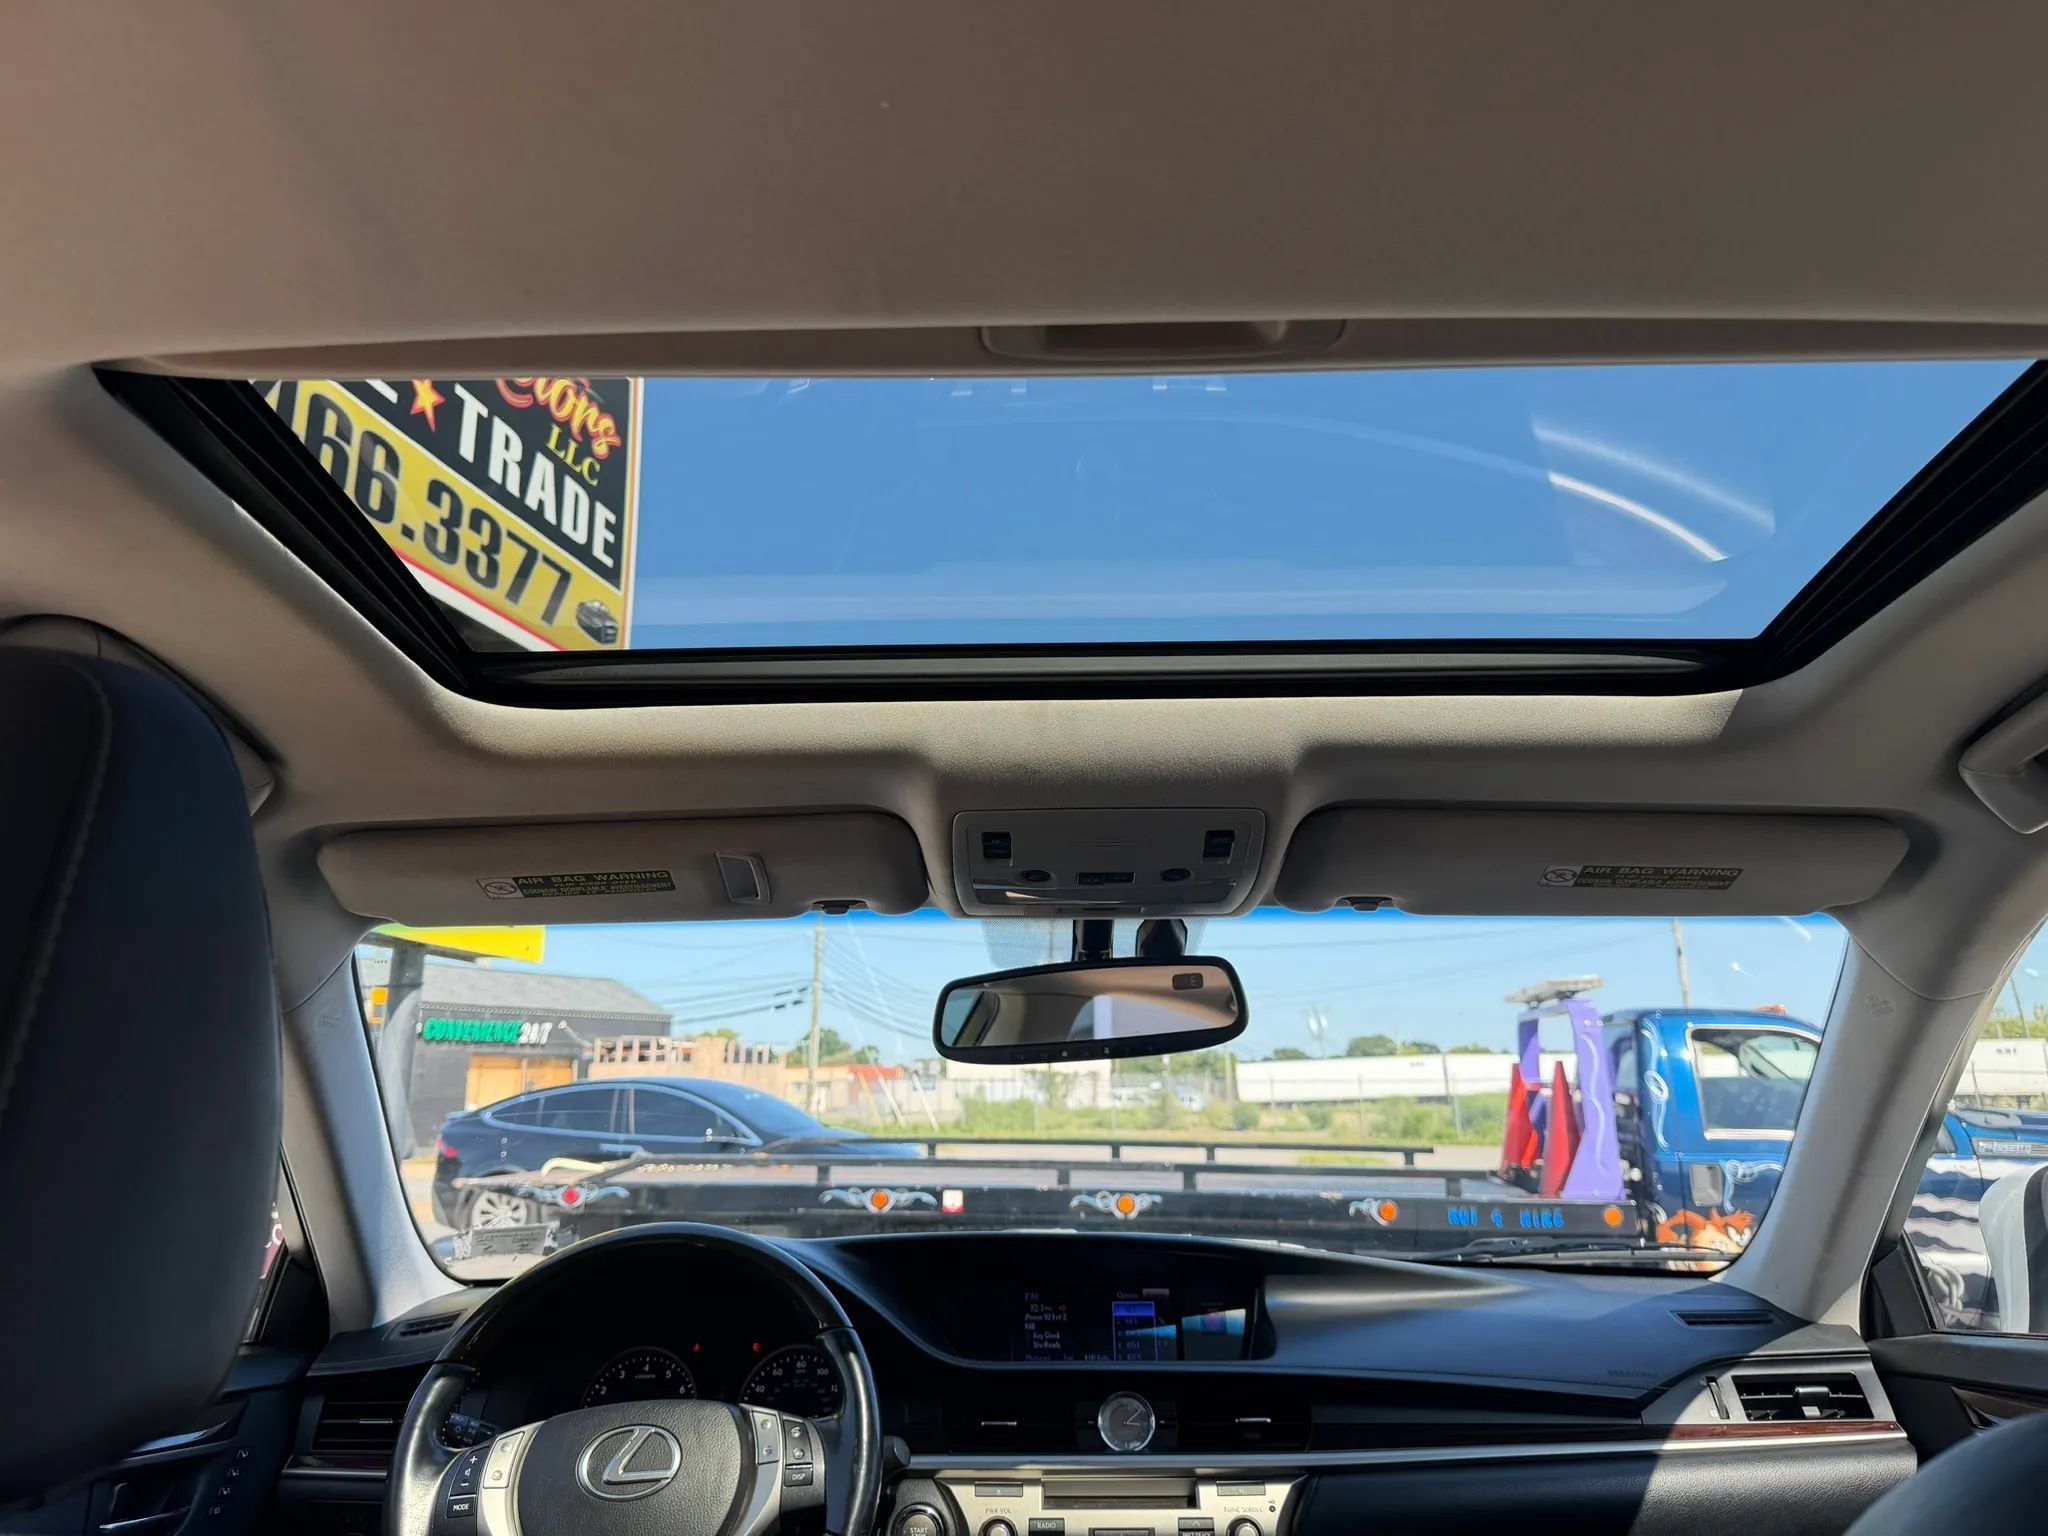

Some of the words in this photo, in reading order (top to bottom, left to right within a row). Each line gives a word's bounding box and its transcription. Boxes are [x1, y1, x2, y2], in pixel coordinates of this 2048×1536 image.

[545, 422, 600, 487] LLC
[454, 383, 617, 569] TRADE
[518, 877, 544, 885] AIR
[551, 874, 586, 883] BAG
[595, 871, 669, 881] WARNING
[1618, 867, 1654, 875] BAG
[1663, 868, 1740, 877] WARNING
[452, 1503, 470, 1511] MODE
